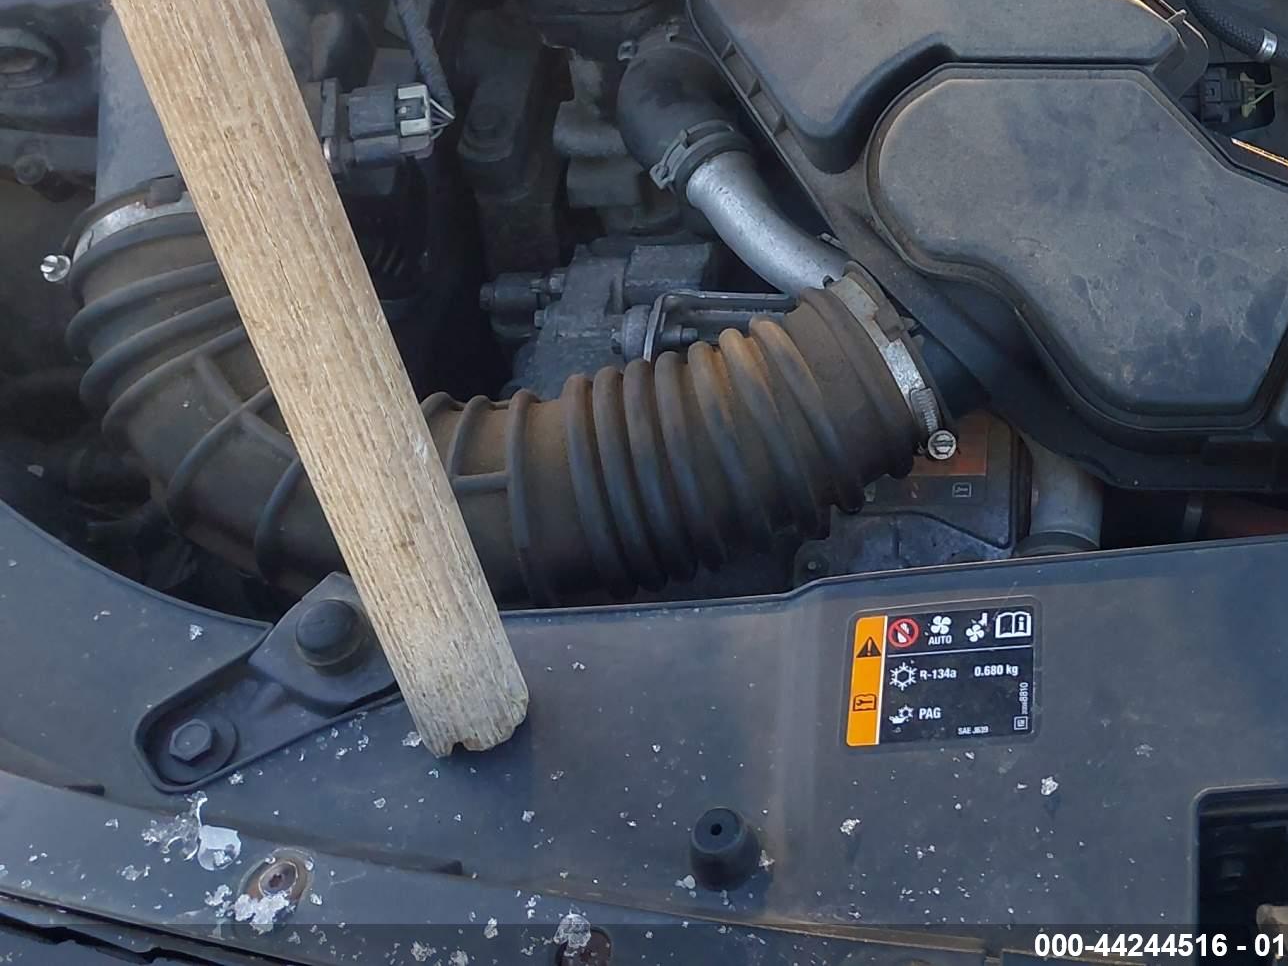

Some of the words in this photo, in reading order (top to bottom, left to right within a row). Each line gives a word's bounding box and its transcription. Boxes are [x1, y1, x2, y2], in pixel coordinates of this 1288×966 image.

[928, 635, 952, 645] AUTO
[920, 668, 957, 680] R-134a
[974, 665, 1003, 677] 0.680
[1006, 664, 1018, 676] kg
[918, 707, 941, 720] PAG
[958, 727, 971, 735] SAE
